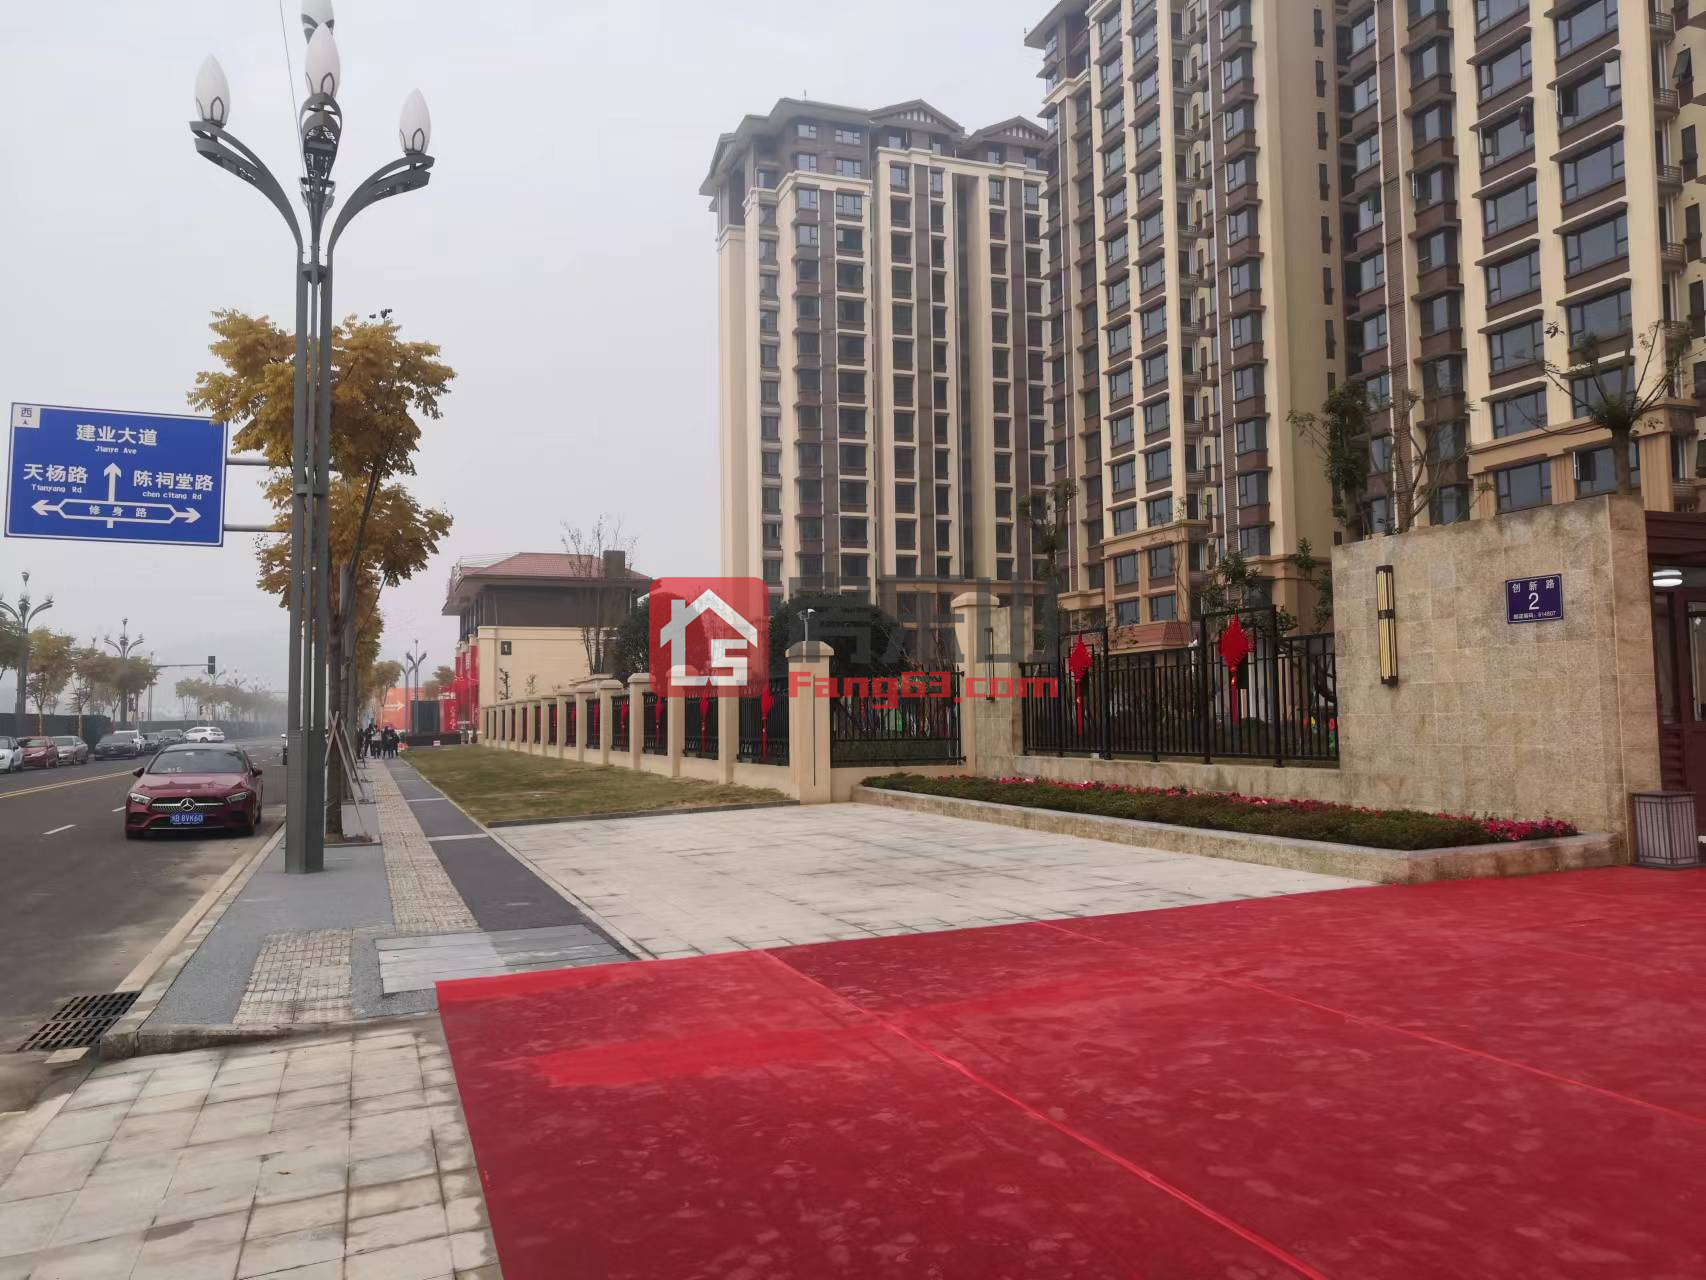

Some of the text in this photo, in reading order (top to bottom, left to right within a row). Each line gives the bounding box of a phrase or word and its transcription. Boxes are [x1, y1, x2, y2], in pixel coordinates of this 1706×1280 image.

[20, 407, 32, 418] 西
[76, 424, 158, 446] 建业大道
[123, 447, 137, 455] Ave
[23, 463, 88, 484] 天杨路
[133, 470, 214, 491] 陈祠堂路
[32, 484, 82, 494] Tianyang Rd
[89, 505, 147, 518] 修身路
[1512, 579, 1555, 594] 创新路
[1528, 592, 1540, 611] 2
